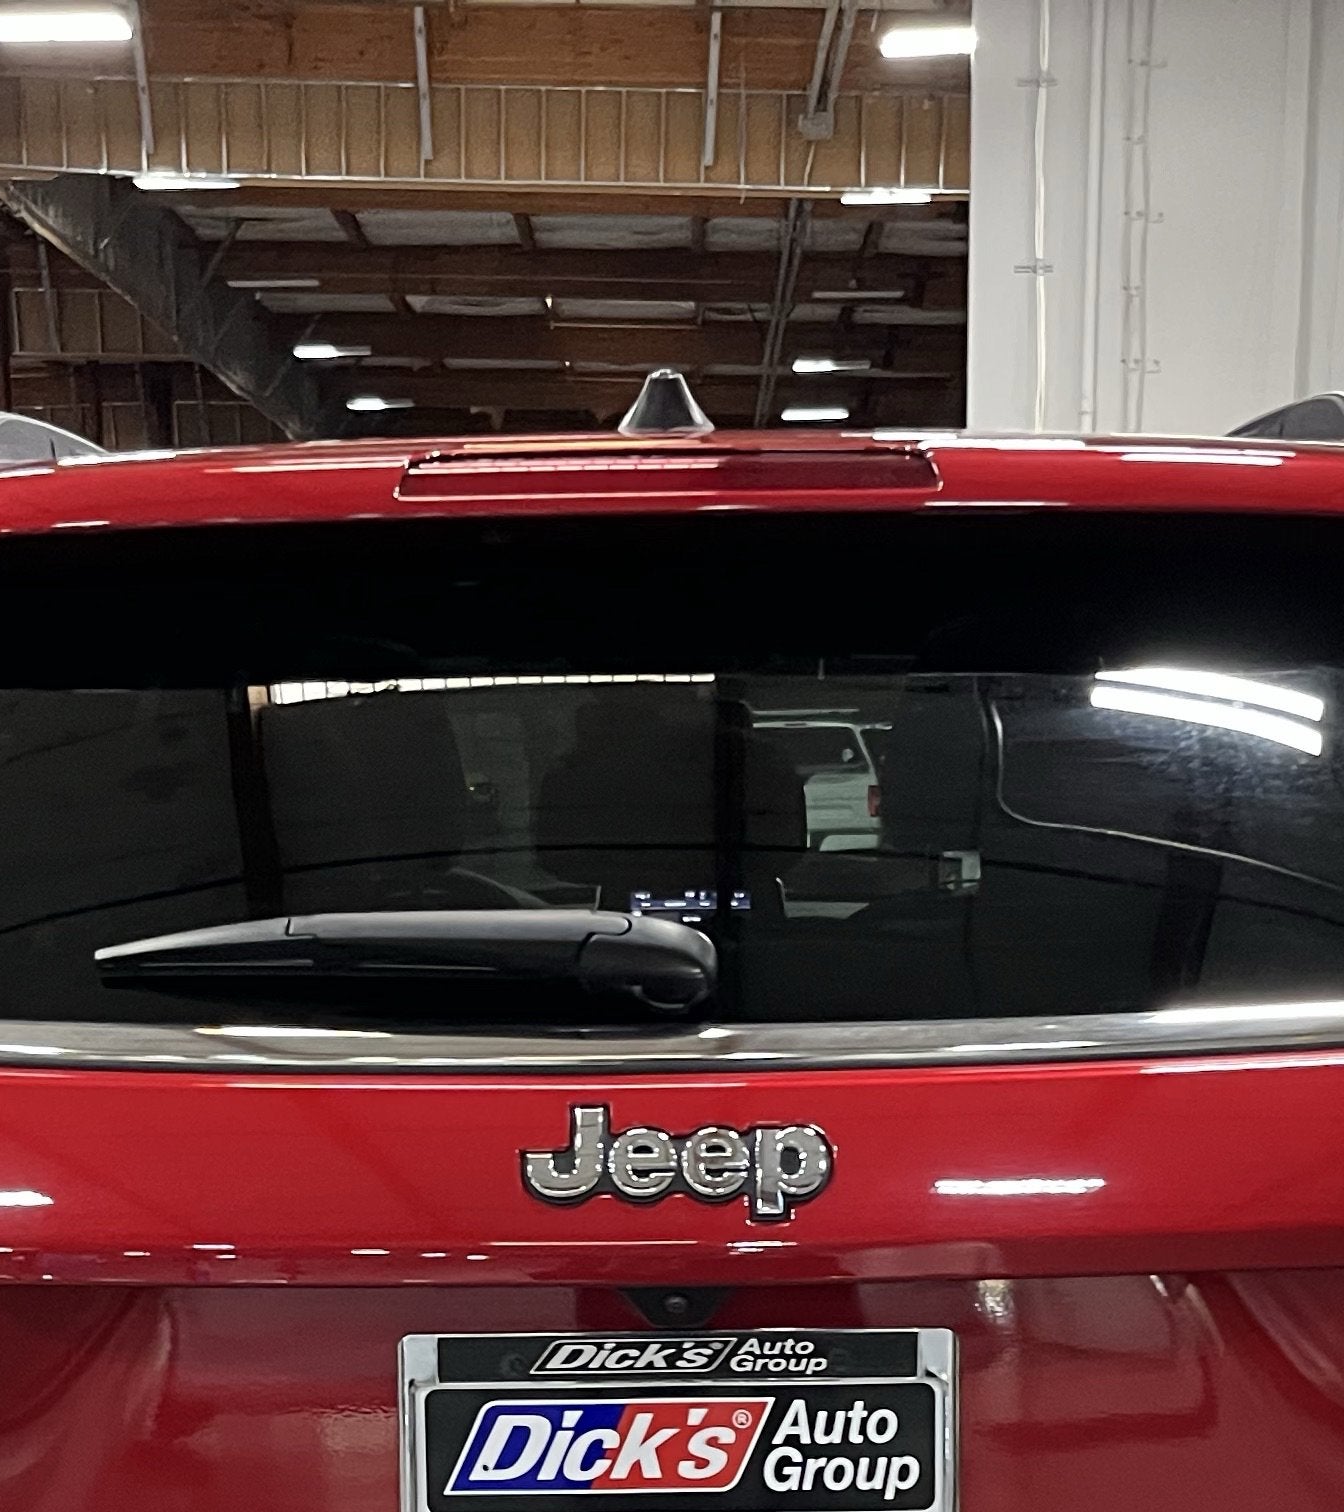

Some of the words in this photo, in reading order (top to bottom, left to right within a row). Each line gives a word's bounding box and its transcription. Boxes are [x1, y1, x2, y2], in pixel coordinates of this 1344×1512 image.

[522, 1103, 832, 1221] Jeep
[545, 1342, 715, 1370] Dick's
[737, 1338, 815, 1355] Auto
[729, 1355, 828, 1375] Group
[773, 1400, 899, 1445] Auto
[762, 1447, 920, 1500] Group
